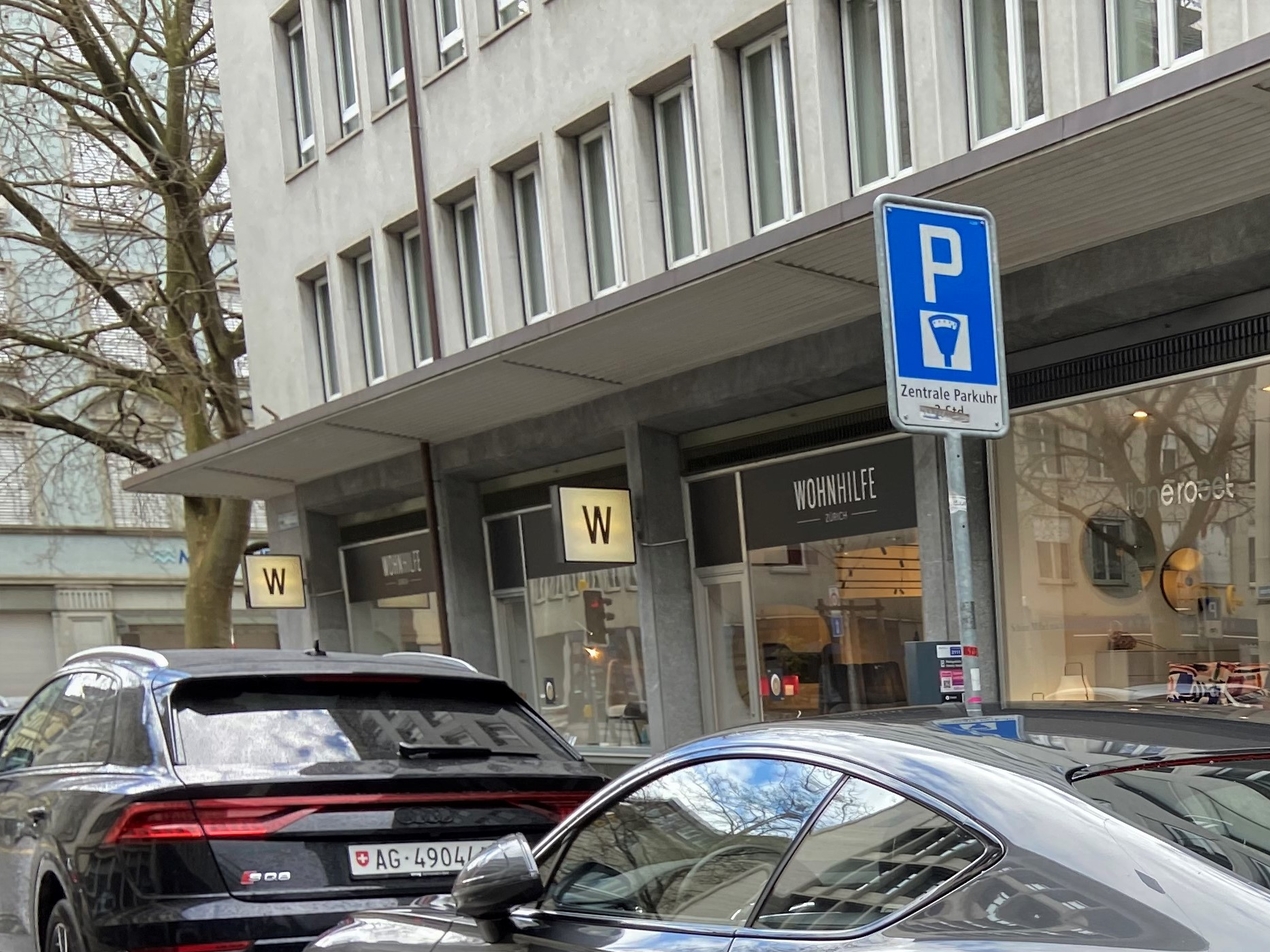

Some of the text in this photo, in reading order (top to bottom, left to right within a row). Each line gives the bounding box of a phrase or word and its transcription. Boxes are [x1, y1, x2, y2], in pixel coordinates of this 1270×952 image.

[919, 223, 963, 303] P
[901, 384, 998, 404] Zentrale Parkuhr
[793, 466, 877, 511] WOHNHILFE
[581, 505, 612, 545] W
[262, 567, 286, 595] W
